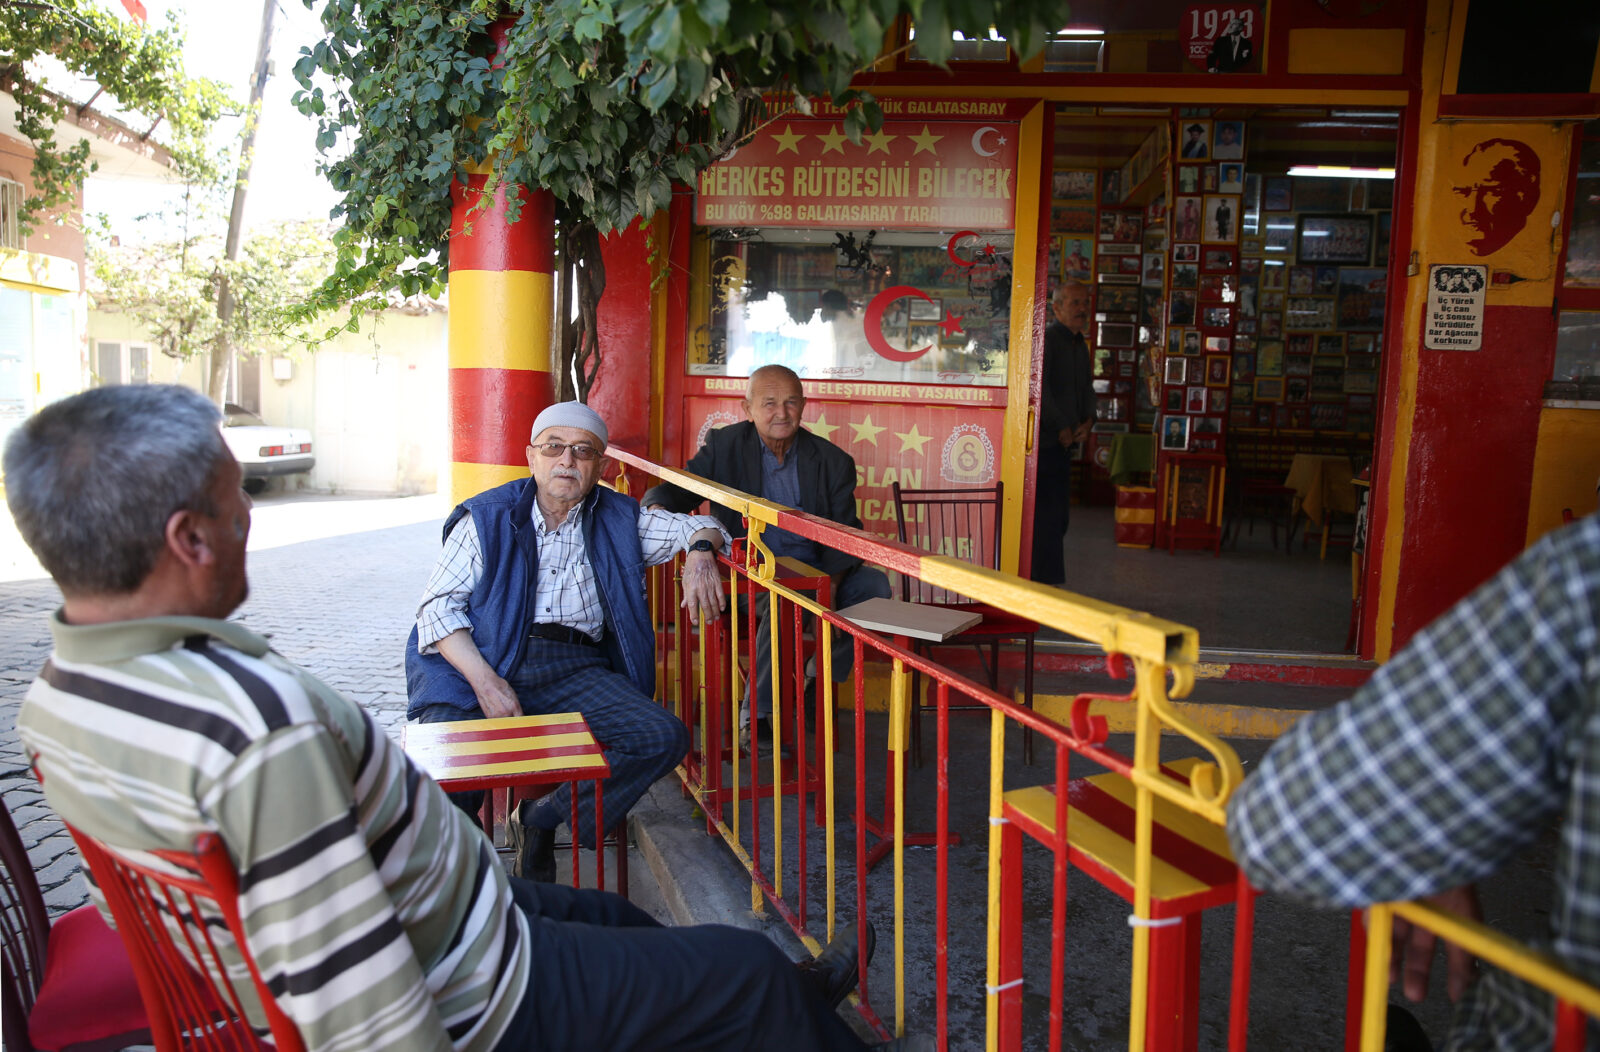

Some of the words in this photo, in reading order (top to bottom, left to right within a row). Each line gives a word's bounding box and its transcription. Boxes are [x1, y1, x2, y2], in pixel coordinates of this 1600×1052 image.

[1190, 9, 1254, 40] 1923
[908, 101, 1007, 115] GALATASARAY
[701, 165, 785, 196] HERKES
[793, 160, 910, 198] RÜTBESİNİ
[918, 161, 1012, 199] BİLECEK
[705, 203, 724, 220] BU
[728, 201, 756, 220] KÖY
[760, 204, 793, 220] %98
[797, 204, 899, 222] GALATASARAY
